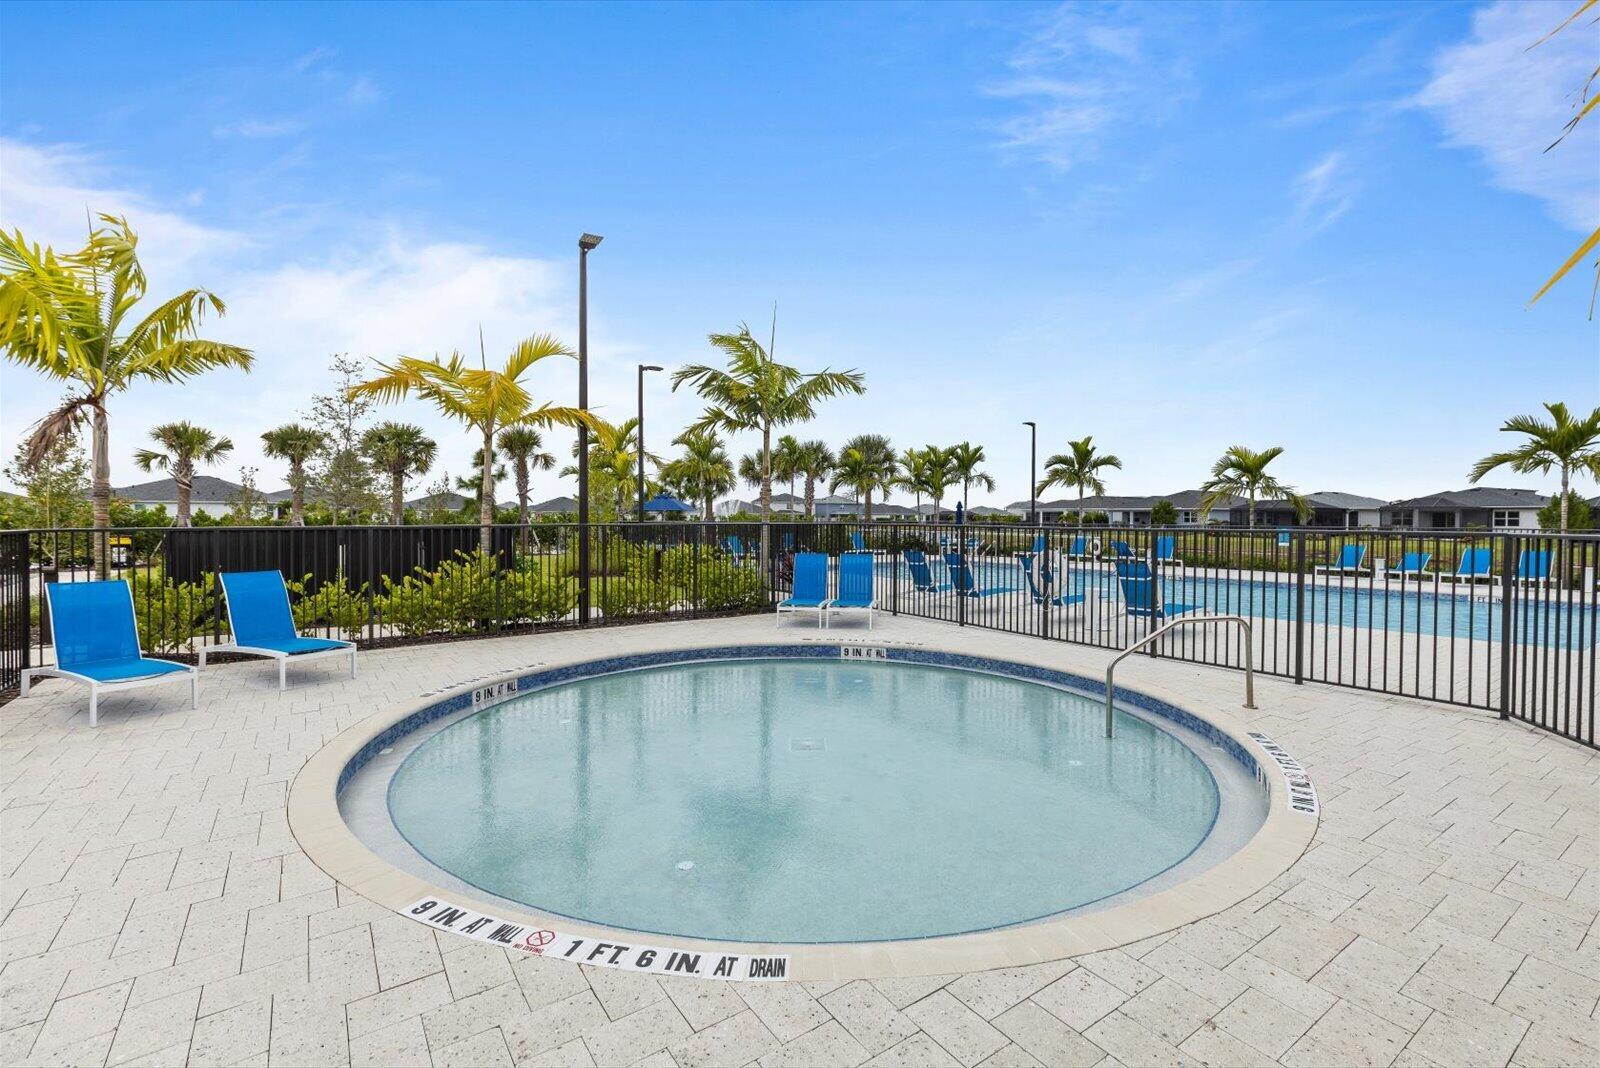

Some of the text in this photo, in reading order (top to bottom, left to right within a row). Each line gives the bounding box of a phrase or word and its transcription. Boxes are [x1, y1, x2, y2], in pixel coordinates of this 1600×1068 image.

[843, 647, 850, 657] 9
[475, 680, 517, 703] 9 IN. AT WALL
[410, 900, 526, 944] 9 IN. AT WALL
[522, 944, 546, 955] DIVING
[563, 939, 788, 978] 1 FT. 6 IN. AT DRAIN
